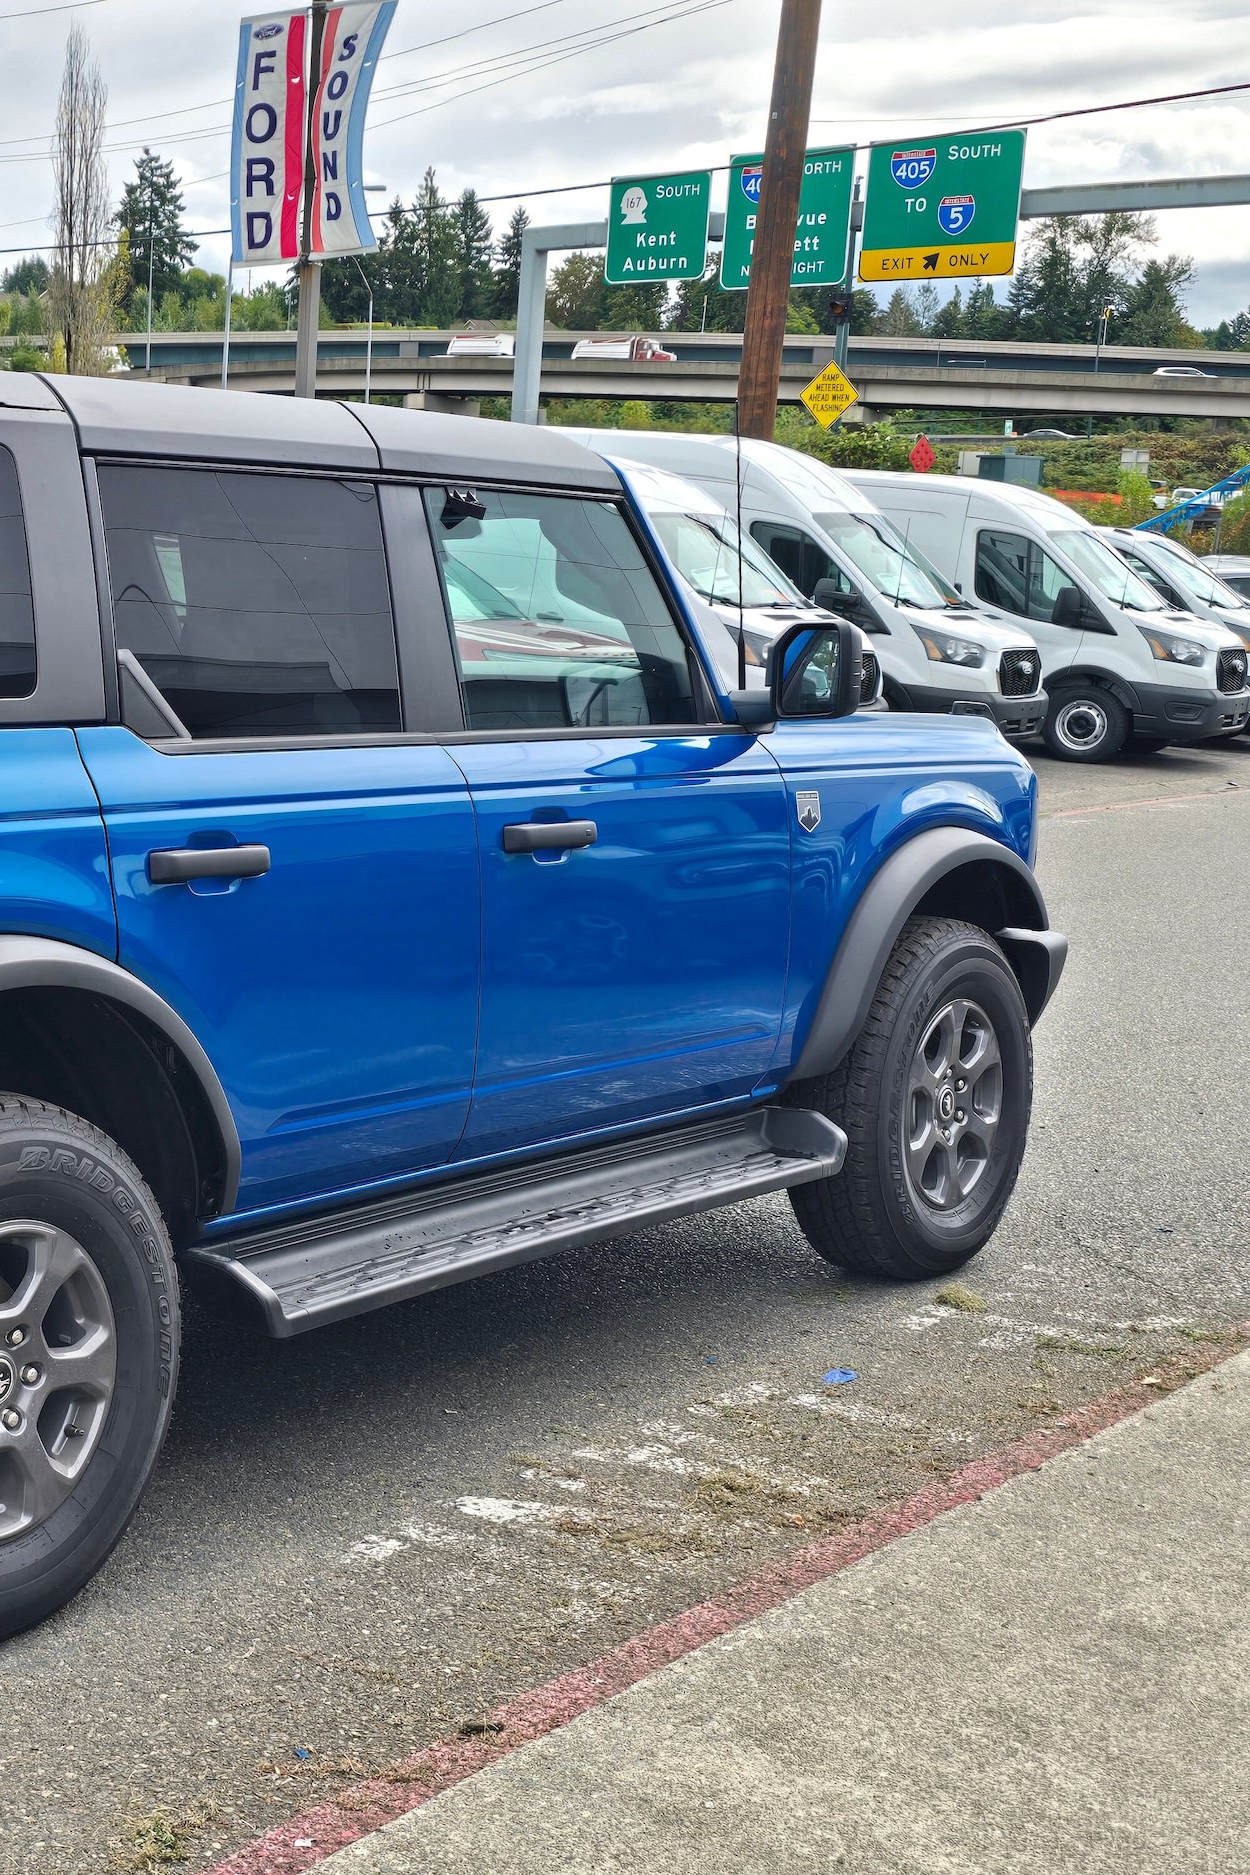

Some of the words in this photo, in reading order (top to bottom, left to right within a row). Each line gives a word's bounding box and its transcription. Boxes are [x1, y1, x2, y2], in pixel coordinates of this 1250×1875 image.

[322, 33, 359, 221] SOUND
[246, 50, 277, 249] FORD
[804, 160, 842, 175] ORTH
[895, 161, 931, 180] 405
[947, 144, 1002, 161] SOUTH
[626, 197, 642, 209] 167
[655, 184, 701, 199] SOUTH
[905, 197, 927, 213] TO
[949, 207, 964, 229] 5
[636, 230, 677, 248] Kent
[622, 256, 688, 273] Auburn
[792, 260, 825, 274] IGHT
[881, 257, 914, 271] EXIT
[949, 252, 990, 267] ONLY
[822, 373, 840, 382] RAMP
[815, 383, 845, 392] METERED
[808, 393, 830, 402] AHEAD
[831, 394, 850, 402] WHEN
[812, 403, 844, 412] FLASHING
[16, 1145, 175, 1400] BRIDGESTONE
